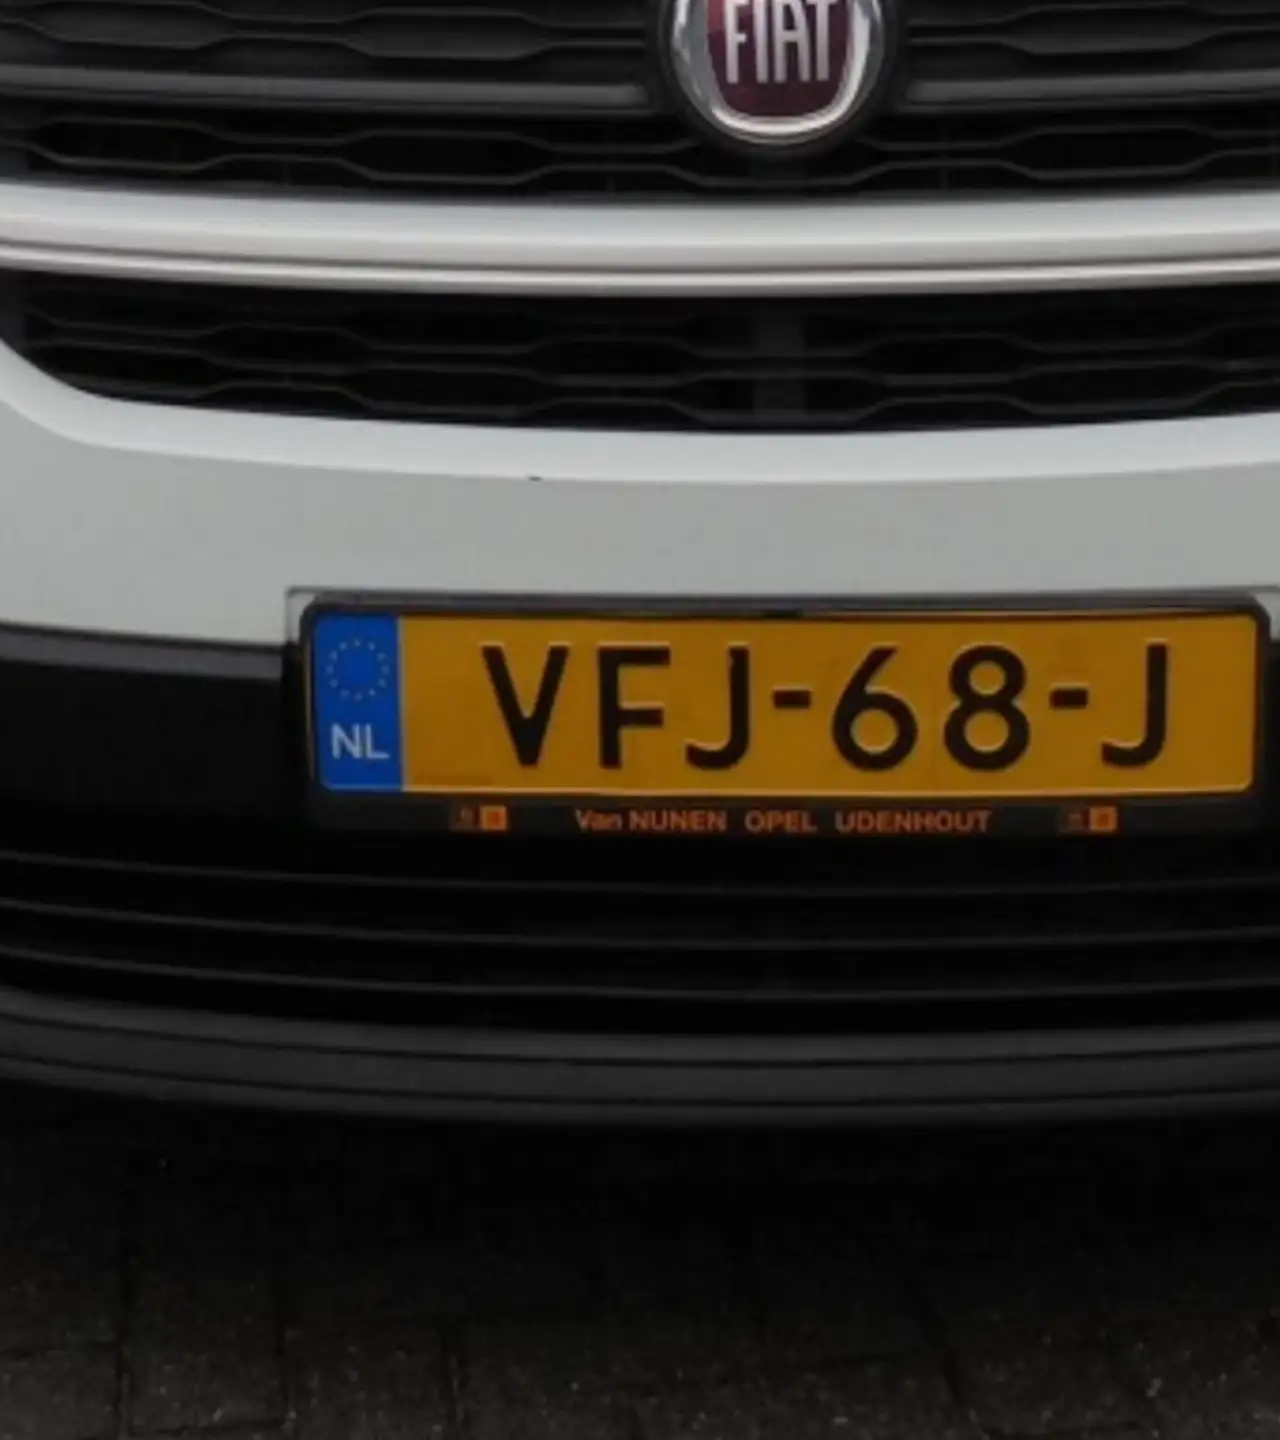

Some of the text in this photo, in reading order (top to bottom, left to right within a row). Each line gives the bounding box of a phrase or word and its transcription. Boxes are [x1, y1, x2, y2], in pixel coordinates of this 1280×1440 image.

[481, 640, 1169, 771] VFJ-68-J
[331, 722, 391, 759] NL
[575, 809, 992, 833] Van NUNEN OPEL UDENHOUT
